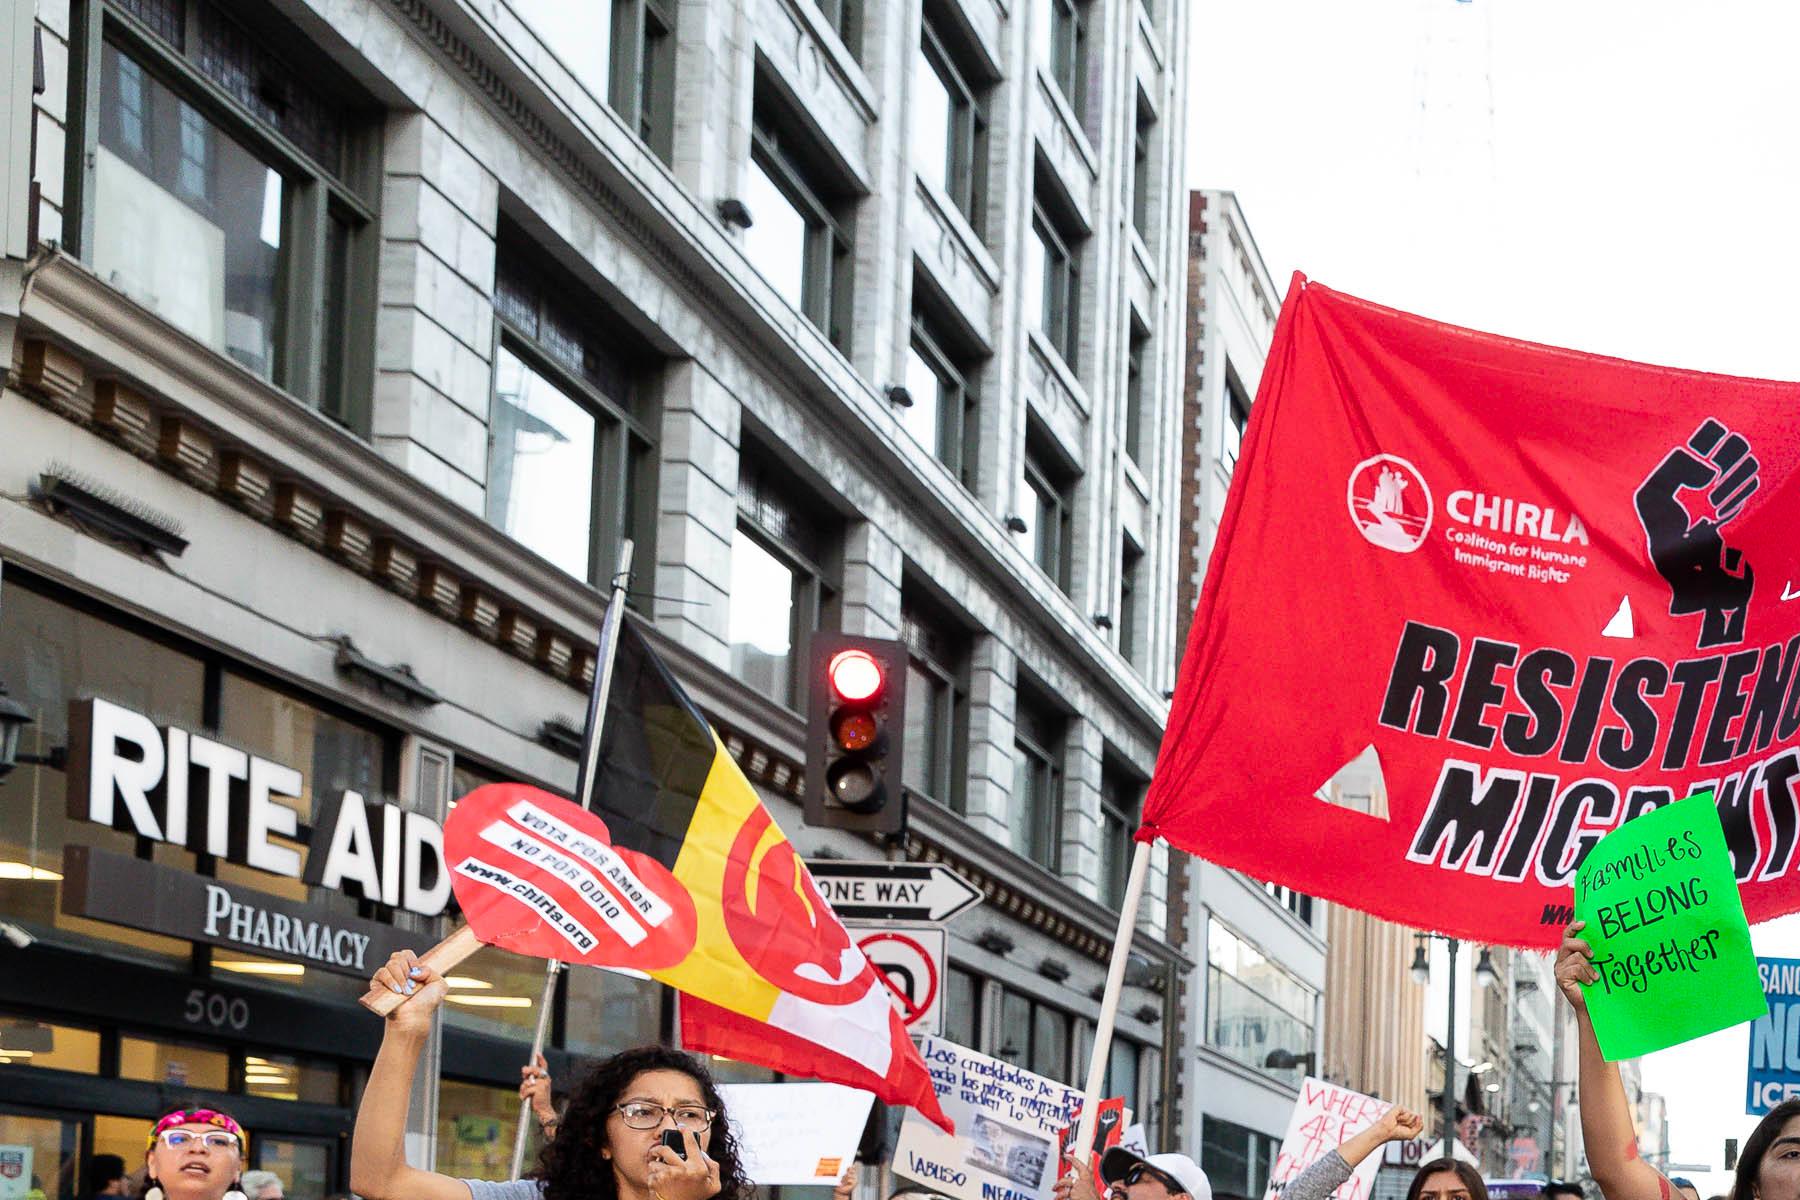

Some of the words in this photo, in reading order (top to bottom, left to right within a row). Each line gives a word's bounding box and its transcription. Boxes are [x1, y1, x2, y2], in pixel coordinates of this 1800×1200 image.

[1445, 527, 1507, 556] Coalition
[1509, 542, 1529, 557] for
[1531, 544, 1588, 568] Humane
[1446, 489, 1590, 547] CHIRLA
[1454, 547, 1526, 577] Immigrant
[1528, 563, 1571, 584] Rights
[88, 696, 303, 878] RITE
[321, 789, 452, 917] AID
[510, 838, 541, 858] NO
[579, 878, 620, 921] ODIO
[520, 811, 567, 843] VOTA
[607, 864, 654, 915] AMOR
[819, 880, 865, 902] ONE
[876, 882, 925, 904] WAY
[463, 861, 594, 950] www.chirla.org
[1596, 877, 1709, 940] BELONG
[1588, 928, 1720, 995] Together
[184, 989, 250, 1031] 500
